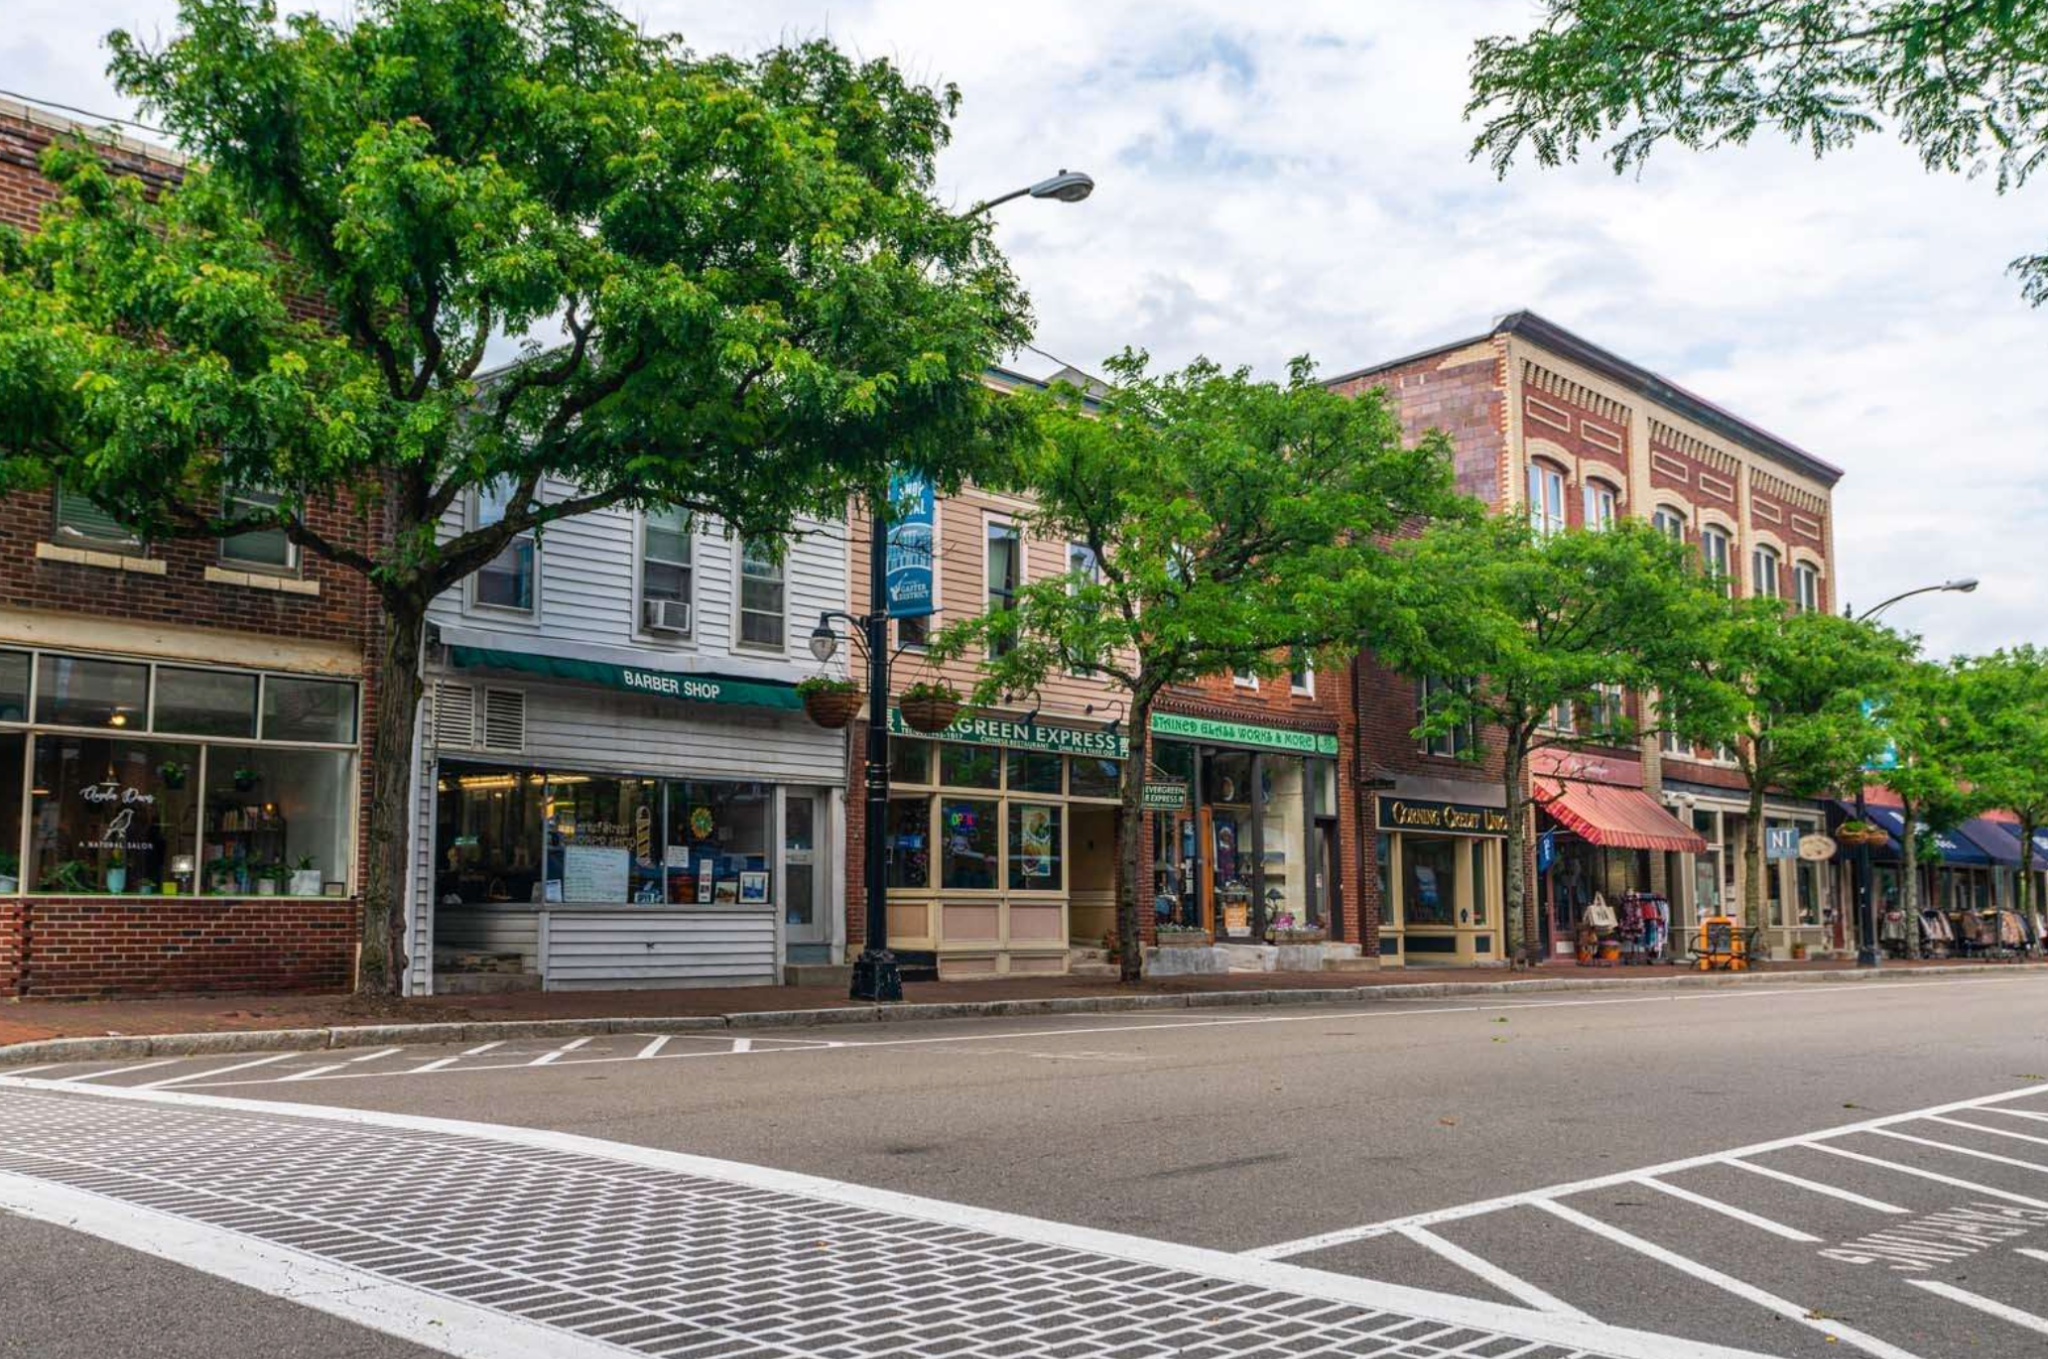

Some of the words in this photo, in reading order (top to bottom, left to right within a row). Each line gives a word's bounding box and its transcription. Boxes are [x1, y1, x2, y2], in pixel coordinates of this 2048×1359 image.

[623, 670, 680, 694] BARBER
[683, 681, 720, 699] SHOP
[1035, 726, 1117, 750] EXPRESS
[1392, 801, 1441, 827] CORNING
[1484, 809, 1509, 832] UNIO
[88, 841, 123, 849] NATURAL
[127, 841, 153, 850] SALON
